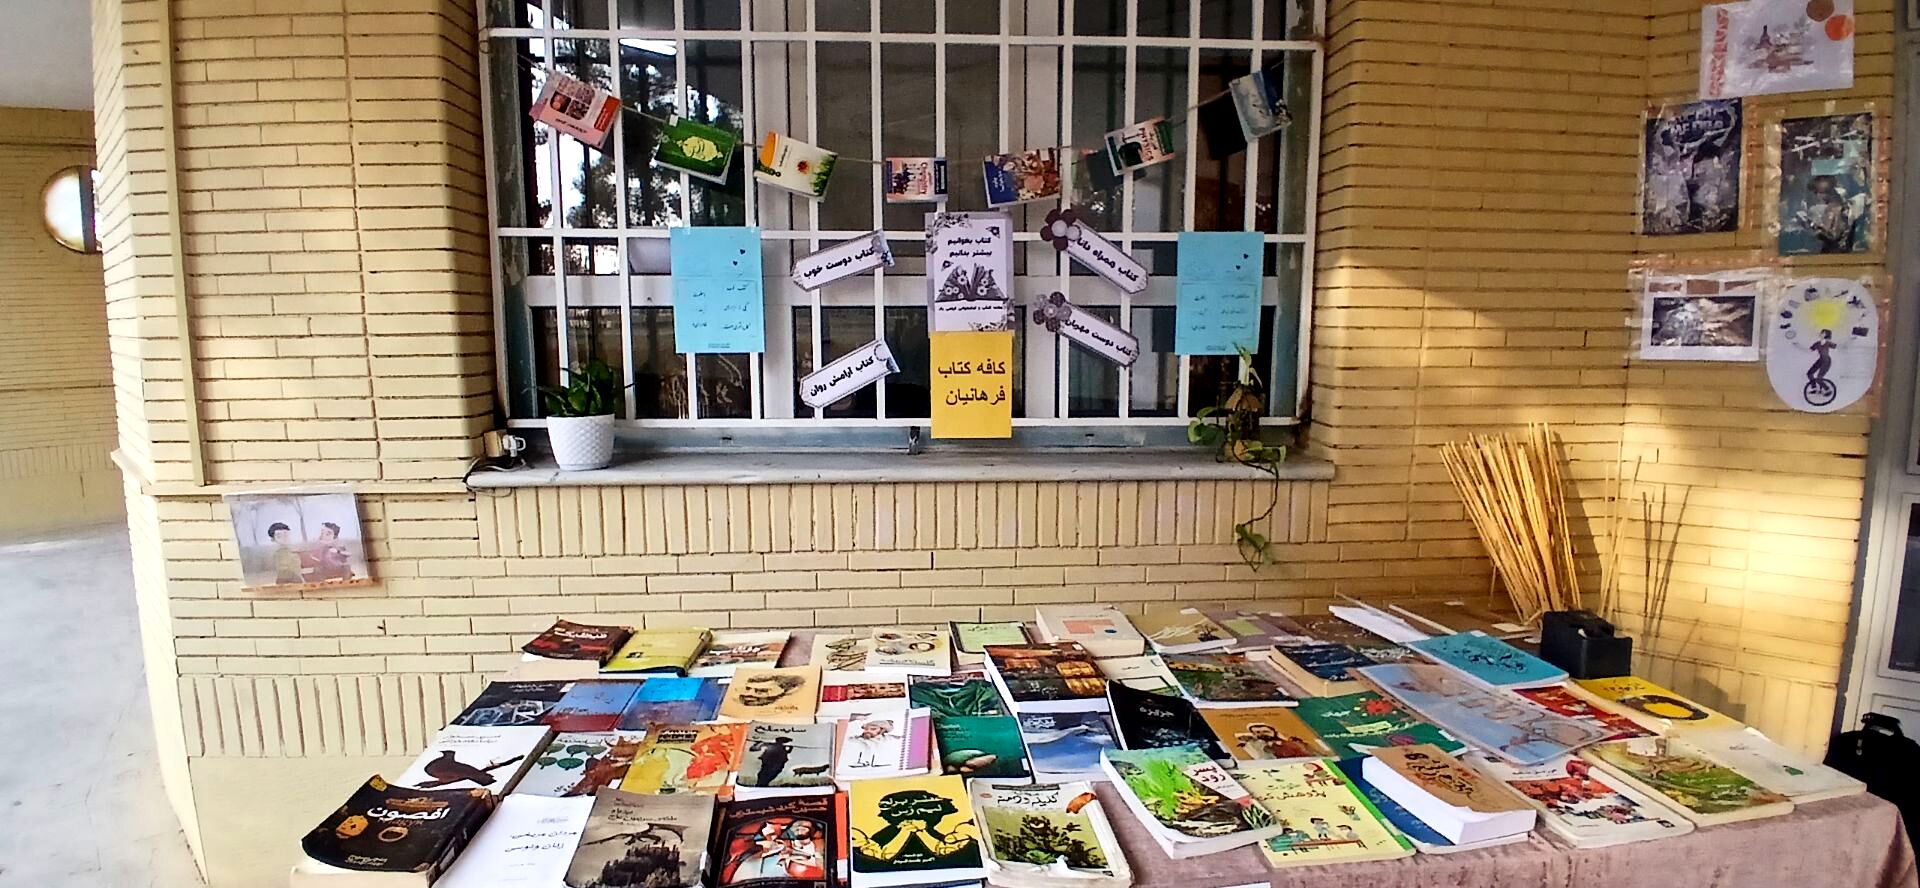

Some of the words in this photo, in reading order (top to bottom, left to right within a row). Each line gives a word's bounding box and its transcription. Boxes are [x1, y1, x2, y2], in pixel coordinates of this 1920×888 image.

[975, 237, 992, 246] کتاب
[855, 246, 875, 262] کتاب
[825, 255, 852, 270] دوست
[803, 265, 823, 280] خوب
[1117, 266, 1140, 282] کتاب
[1091, 331, 1114, 347] دوست
[1115, 344, 1132, 356] کتاب
[855, 356, 874, 373] کتاب
[937, 361, 972, 379] کتاب
[976, 358, 1006, 375] کافه
[809, 383, 827, 397] روان
